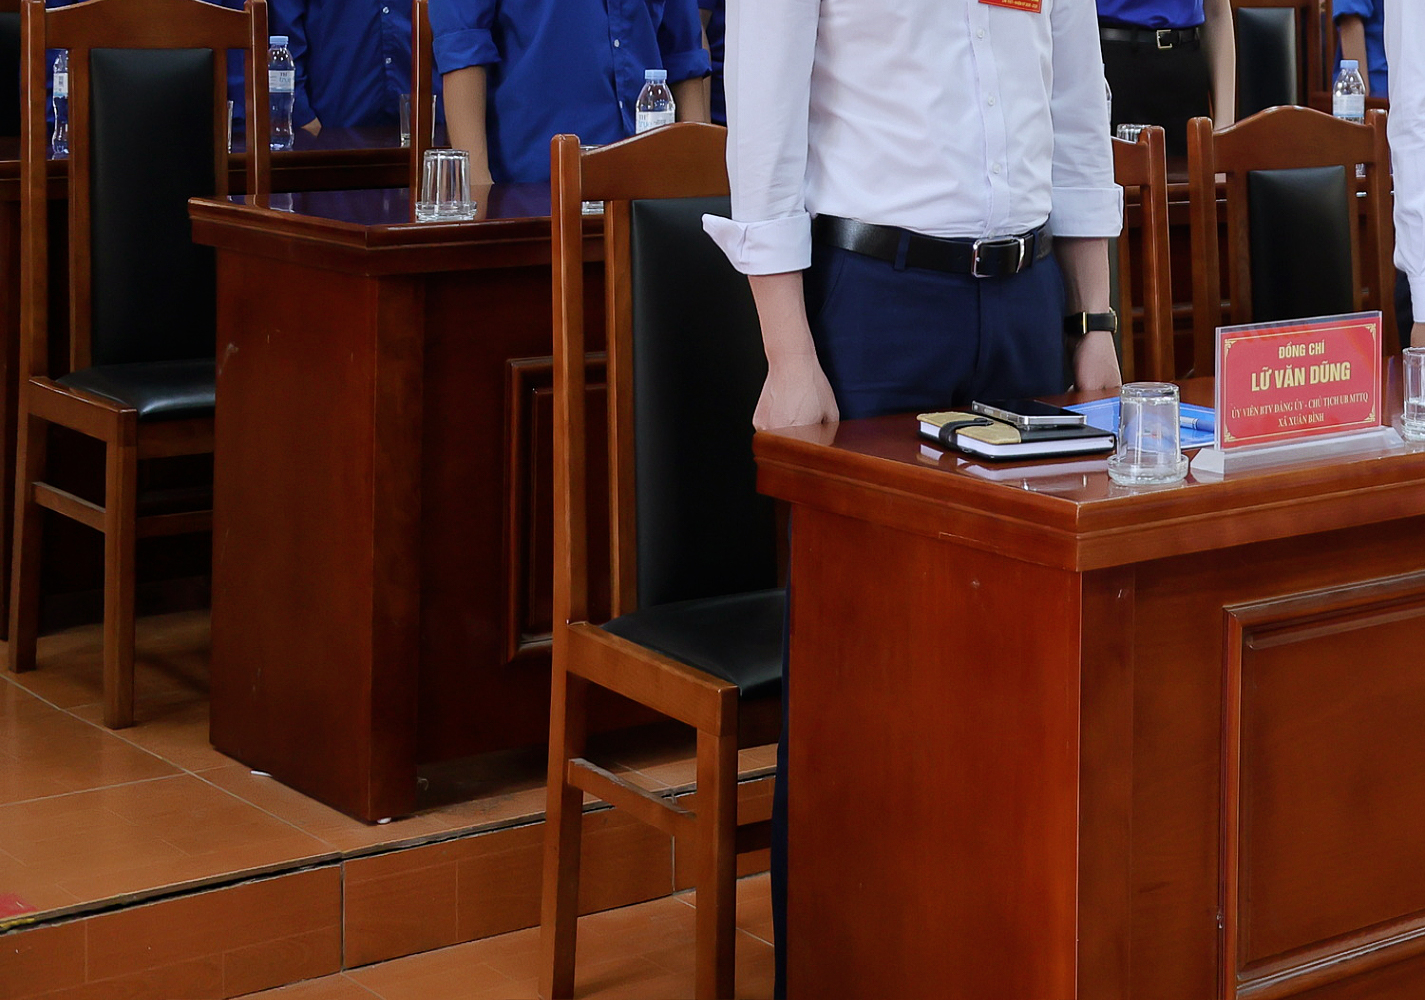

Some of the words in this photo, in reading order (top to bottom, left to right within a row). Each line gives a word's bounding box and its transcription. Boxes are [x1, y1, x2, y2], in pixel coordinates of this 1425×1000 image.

[1278, 341, 1306, 359] ĐỒNG
[1308, 339, 1325, 355] CHÍ
[1251, 366, 1272, 391] LỮ
[1274, 364, 1305, 388] VĂN
[1310, 360, 1351, 384] DŨNG
[1242, 404, 1259, 417] VIÊN
[1259, 406, 1274, 415] BTV
